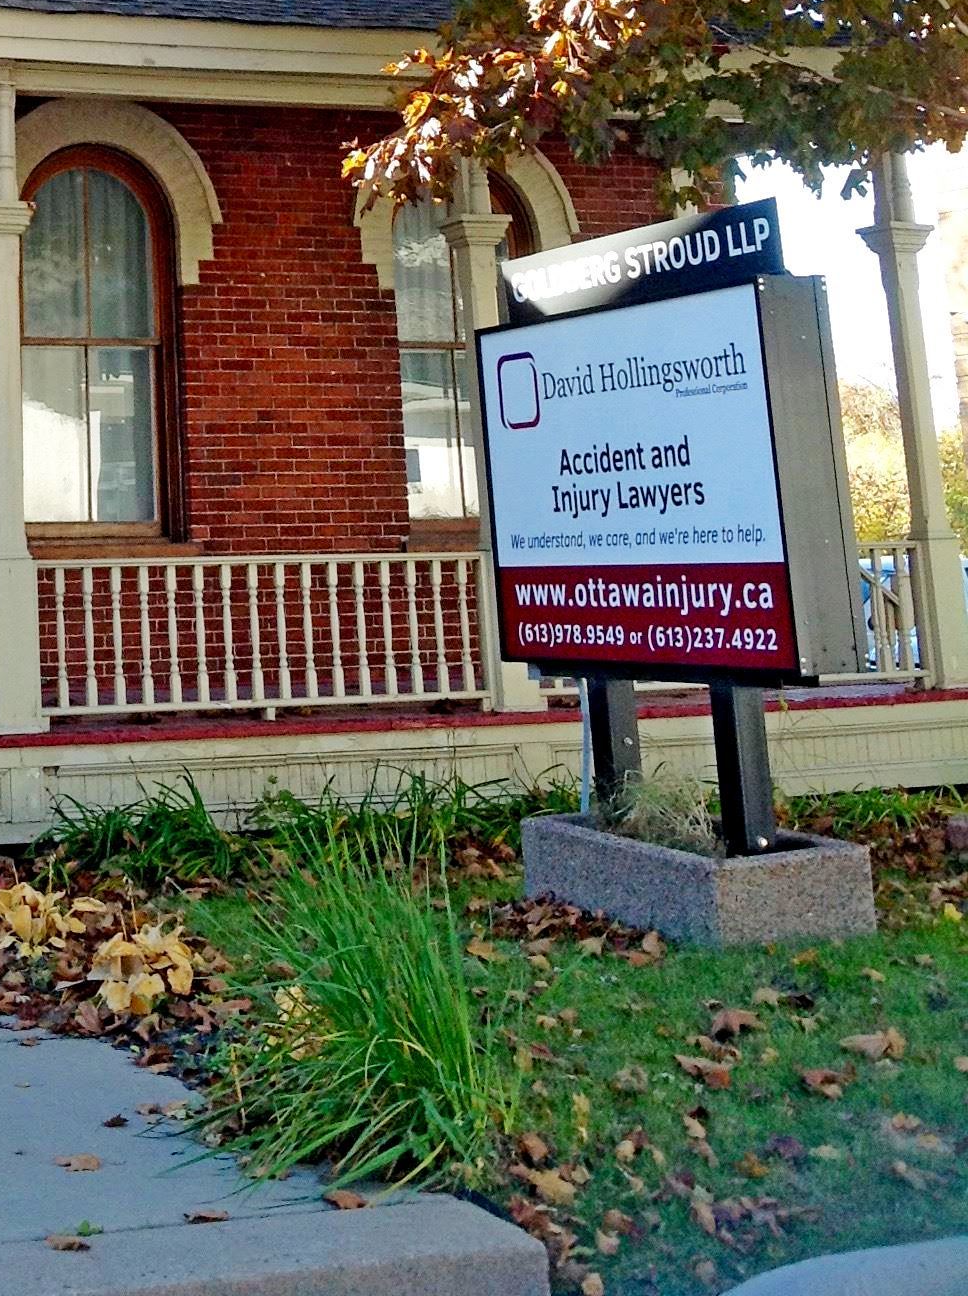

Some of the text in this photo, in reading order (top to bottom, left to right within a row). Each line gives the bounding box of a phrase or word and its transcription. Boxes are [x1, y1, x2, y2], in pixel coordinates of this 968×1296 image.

[624, 229, 721, 280] STROUD
[726, 217, 770, 257] LLP
[542, 342, 747, 400] David Hollingsworth
[675, 381, 748, 398] Professional Corporation
[559, 435, 691, 476] Accident and
[552, 480, 705, 518] Injury Lawyers
[511, 524, 766, 549] We understand, we care, and we're here to help.
[515, 575, 774, 616] www.ottawainjury.ca
[518, 622, 778, 653] (613)978.9549 or (613)237.4922
